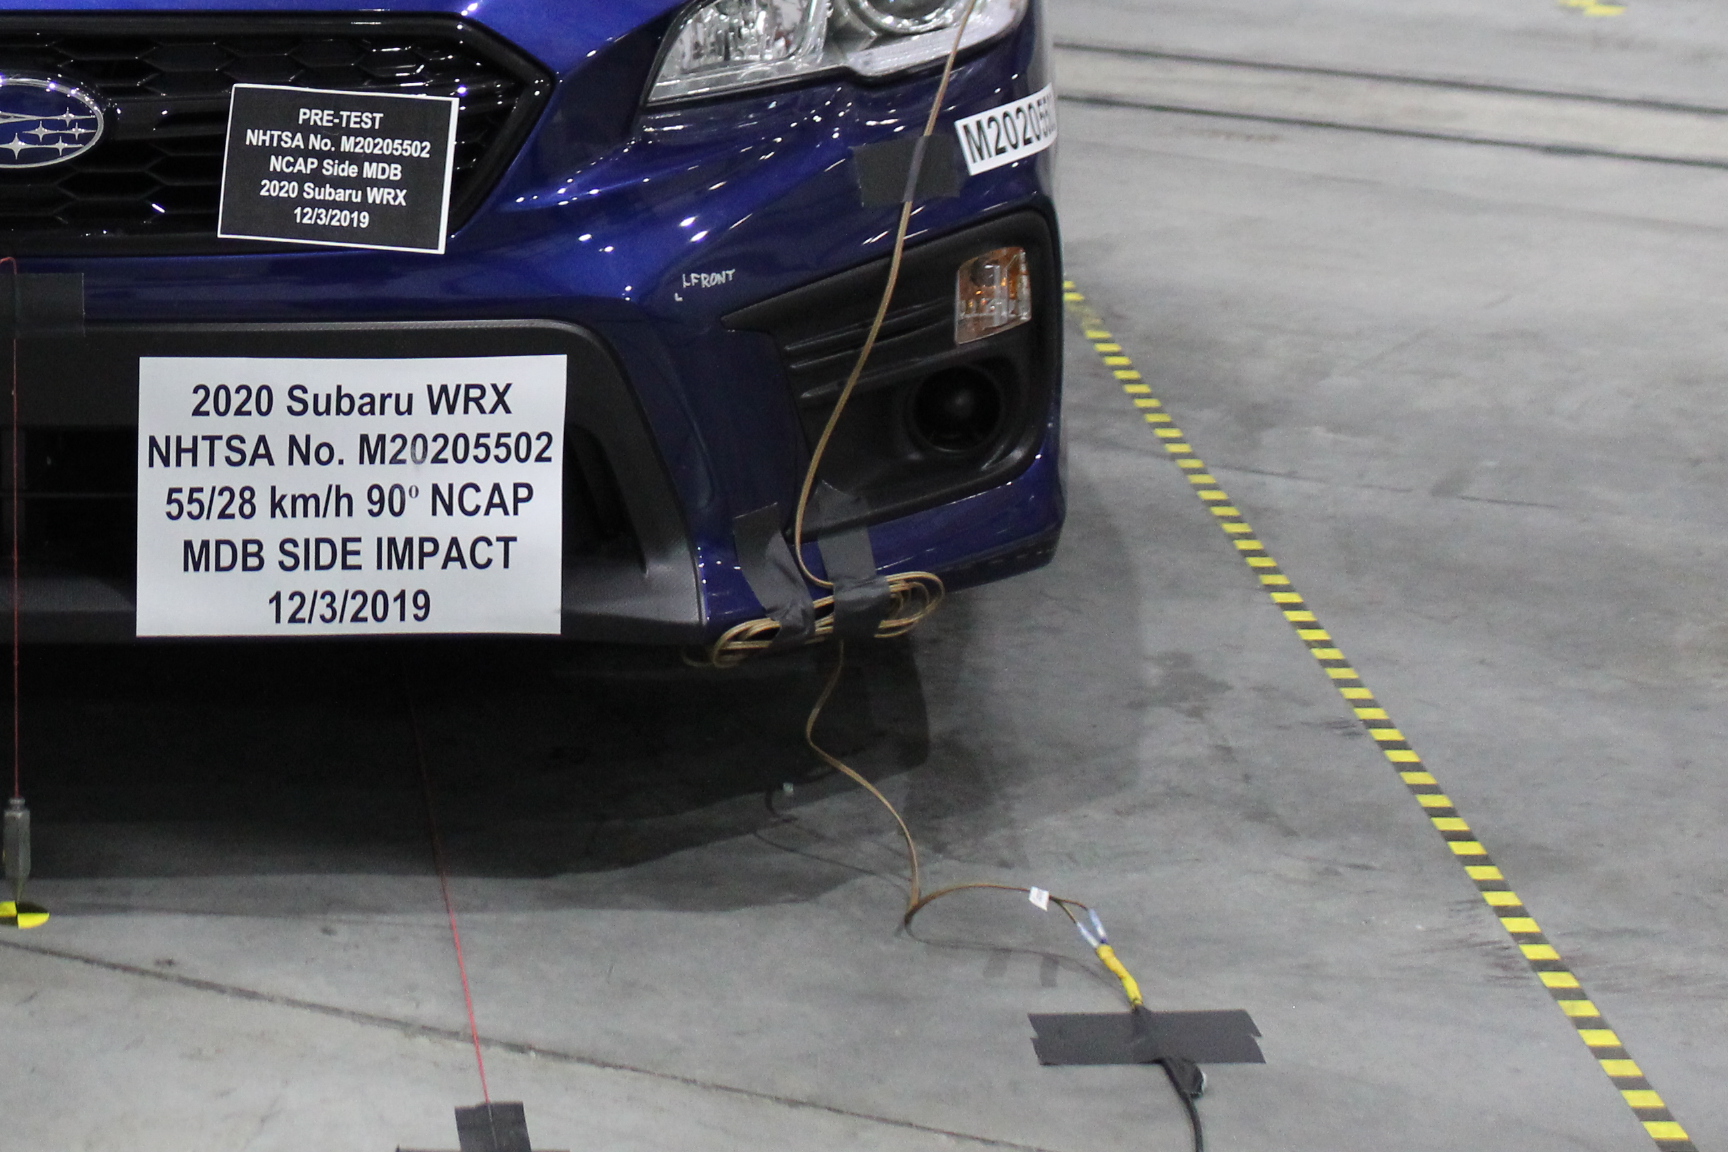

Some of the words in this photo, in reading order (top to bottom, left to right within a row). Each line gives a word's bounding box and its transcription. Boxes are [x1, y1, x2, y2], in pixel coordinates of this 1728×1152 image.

[298, 108, 384, 130] PRE-TEST
[245, 129, 304, 149] NHTSA
[308, 134, 336, 152] No.
[340, 136, 432, 158] M20205502
[269, 155, 319, 175] NCAP
[322, 160, 359, 178] Side
[362, 162, 403, 181] MDB
[259, 180, 299, 198] 2020
[302, 182, 362, 203] Subaru
[366, 187, 408, 206] WRX
[293, 207, 370, 228] 12/3/2019
[191, 383, 274, 417] 2020
[285, 384, 414, 417] Subaru
[426, 382, 514, 415] WRX
[147, 434, 275, 468] NHTSA
[287, 434, 345, 467] No.
[358, 431, 554, 466] M20205502
[165, 485, 257, 520] 55/28
[269, 483, 354, 519] km/h
[430, 482, 535, 517] NCAP
[182, 538, 266, 573] MDB
[277, 536, 363, 571] SIDE
[375, 535, 518, 571] IMPACT
[267, 588, 432, 624] 12/3/2019
